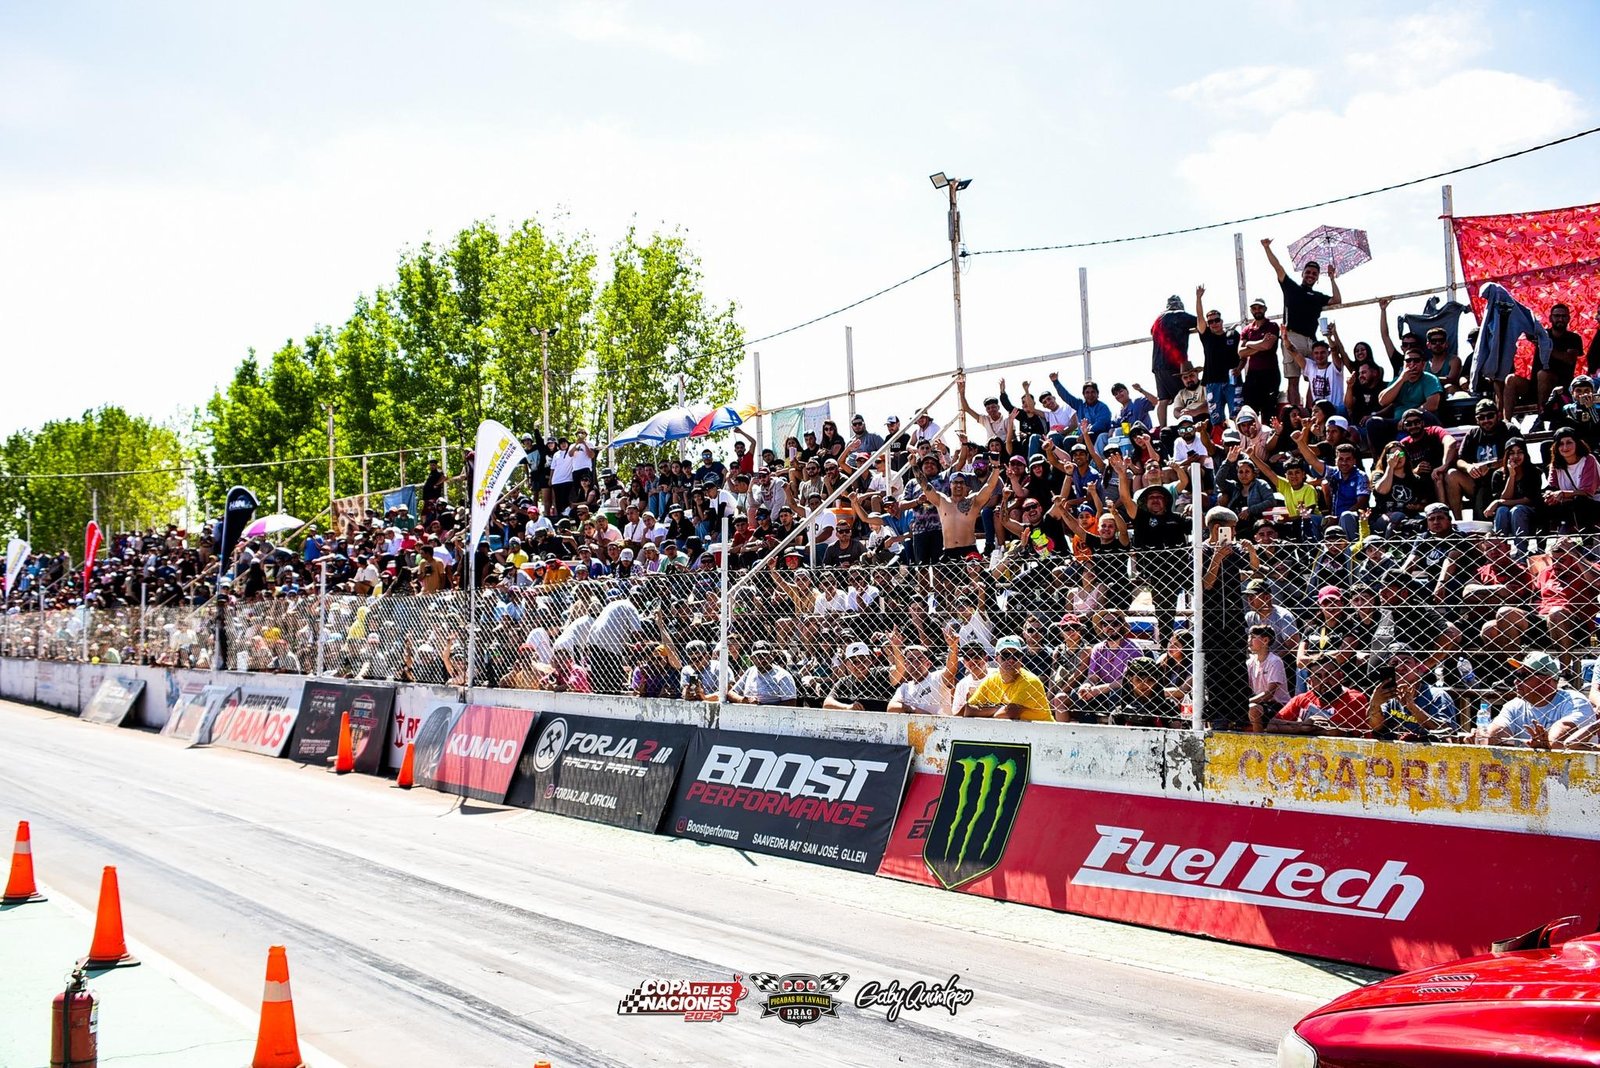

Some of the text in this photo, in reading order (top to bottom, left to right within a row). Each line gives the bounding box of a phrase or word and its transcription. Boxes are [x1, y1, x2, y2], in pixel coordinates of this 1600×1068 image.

[228, 710, 291, 748] RAMOS
[446, 732, 517, 764] KUMHO
[562, 757, 648, 778] RACING PARTS
[697, 744, 889, 803] BOOST
[686, 782, 874, 829] PERFORMANCE
[686, 819, 740, 841] Boostperformza
[752, 833, 868, 864] SAAVEDRA 847 SAN JOSÉ, GLLEN
[1082, 824, 1425, 921] FuelTech
